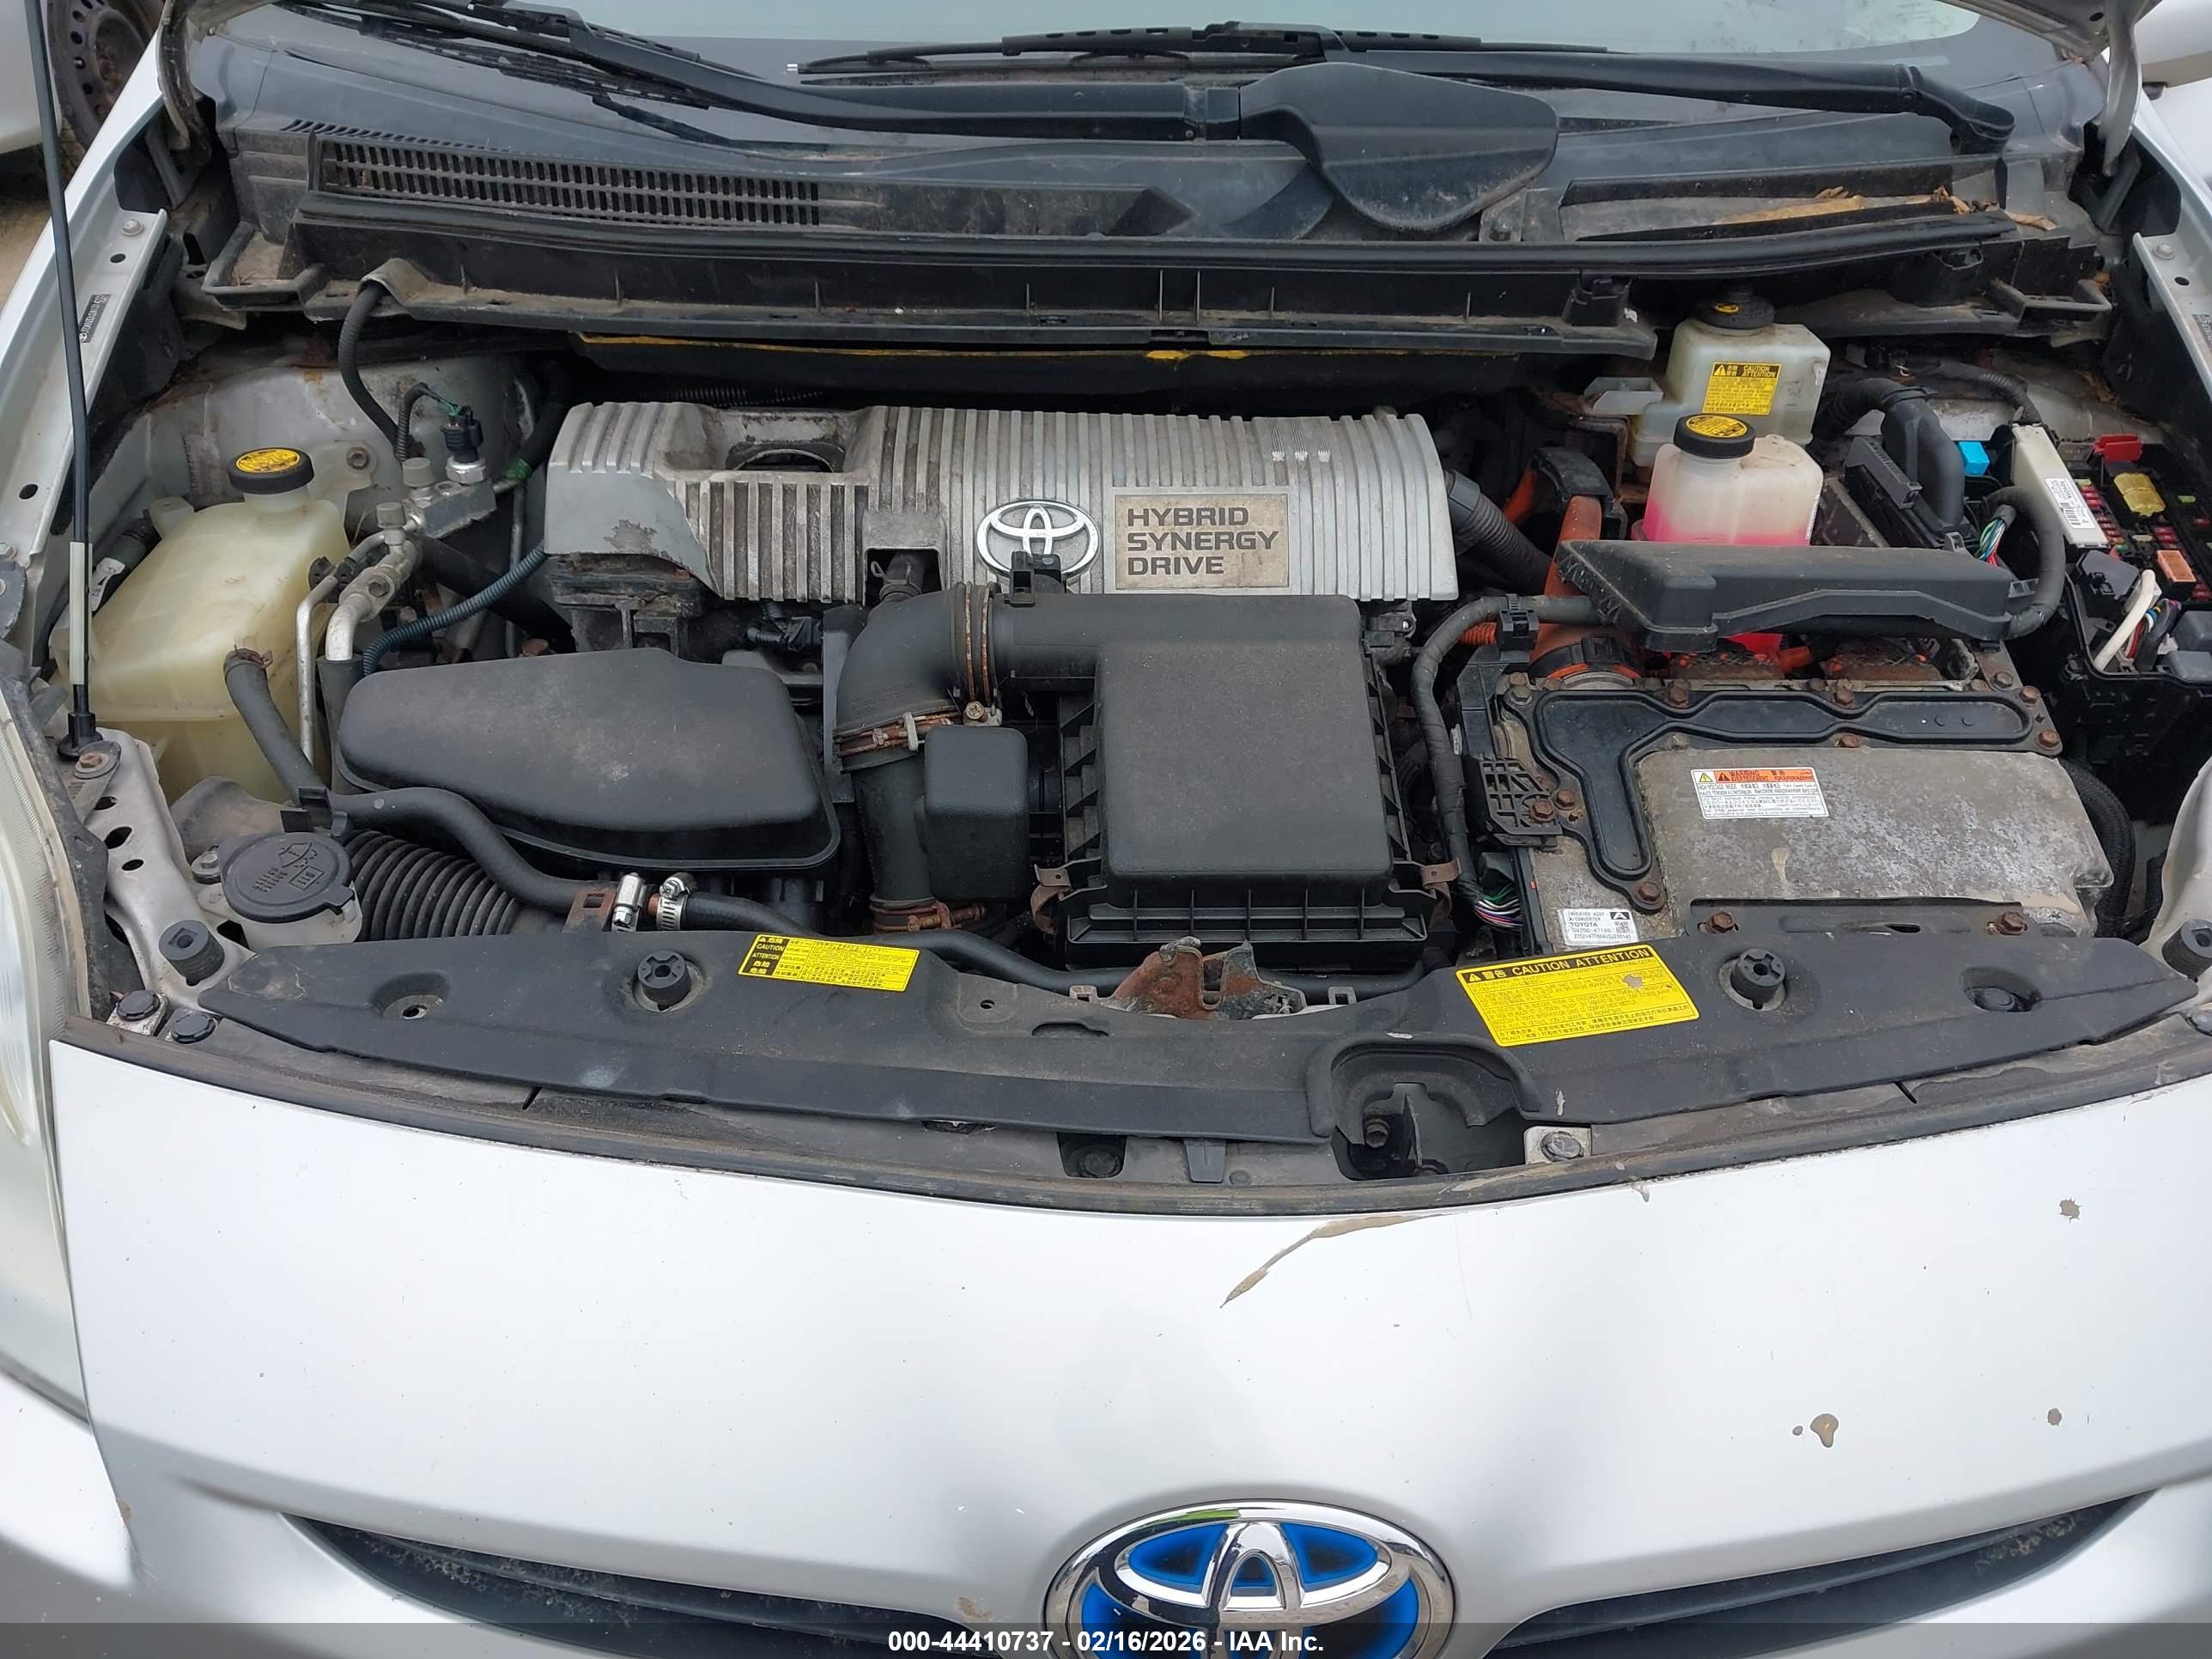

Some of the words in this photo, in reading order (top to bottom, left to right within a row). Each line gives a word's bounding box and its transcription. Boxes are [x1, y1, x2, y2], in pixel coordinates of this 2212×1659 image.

[1127, 507, 1249, 527] HYBRID
[1127, 531, 1279, 551] SYNERGY
[1127, 556, 1224, 575] DRIVE
[751, 951, 781, 961] ATTENTION
[757, 943, 786, 951] CAUTION
[1511, 959, 1571, 976] CAUTION
[1576, 948, 1651, 968] ATTENTION
